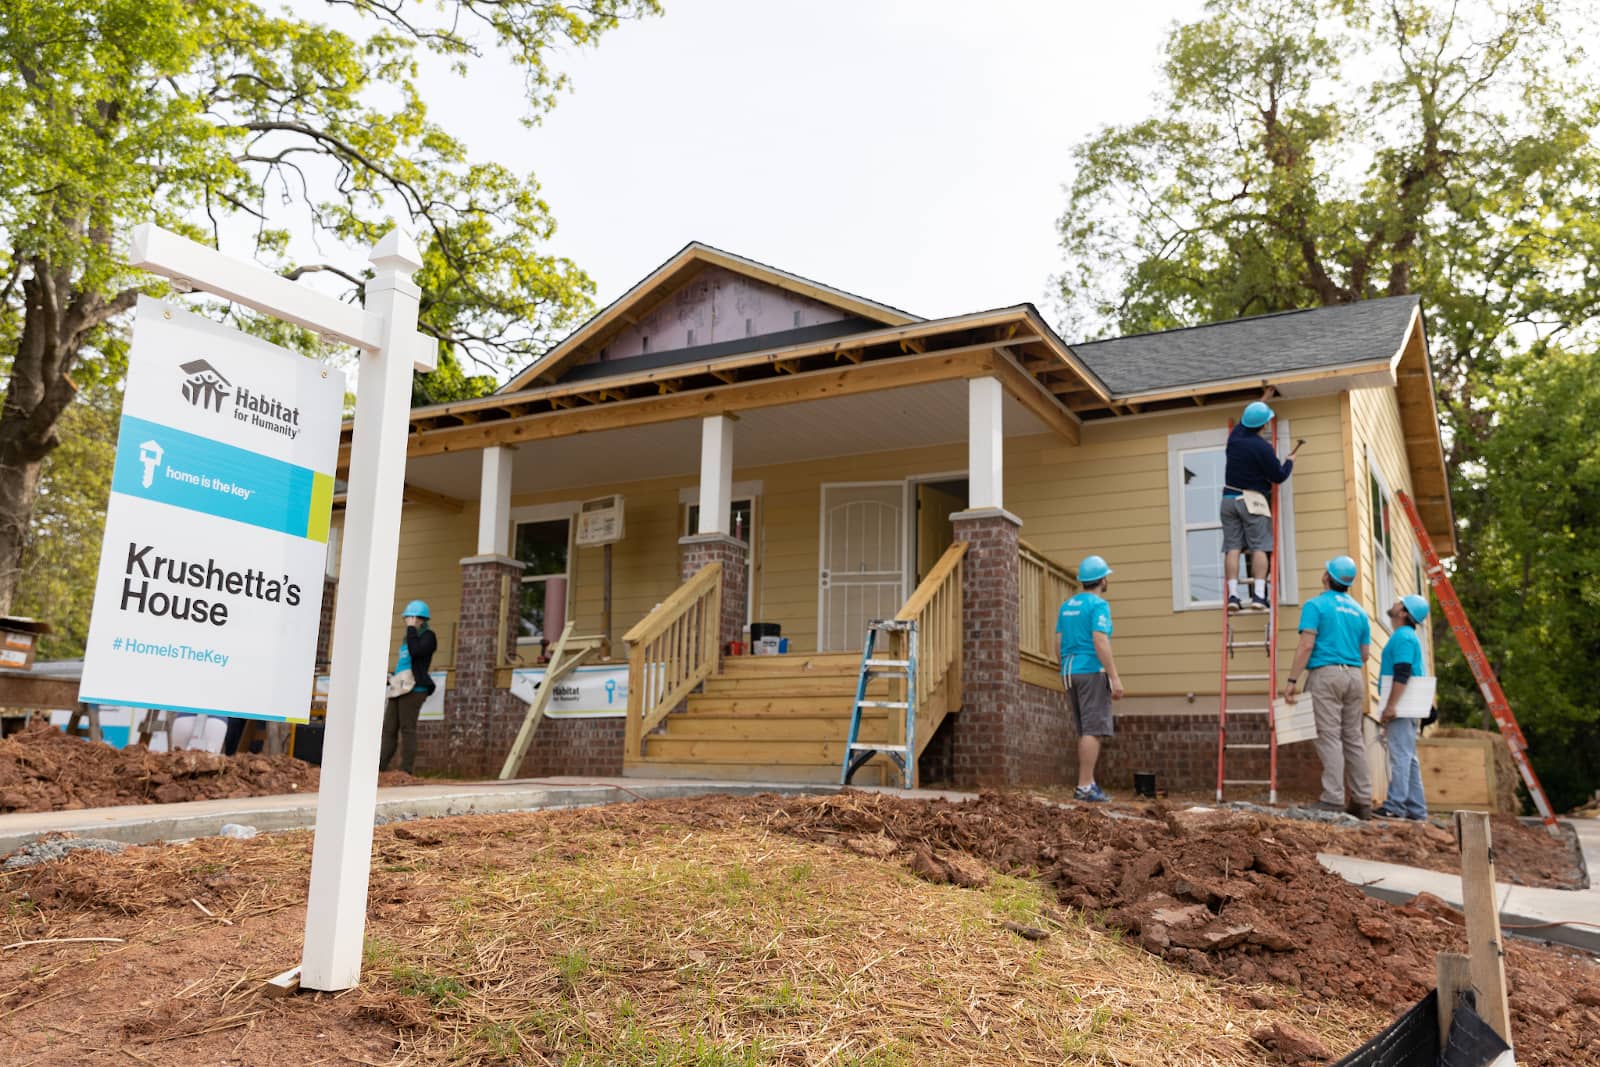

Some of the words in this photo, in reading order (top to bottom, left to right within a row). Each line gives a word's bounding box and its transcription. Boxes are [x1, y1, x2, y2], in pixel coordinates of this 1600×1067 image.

[233, 408, 249, 422] for
[251, 413, 298, 440] Humanity
[235, 386, 300, 426] Habitat
[166, 465, 200, 485] home
[201, 474, 211, 488] is
[212, 478, 230, 493] the
[231, 483, 250, 501] key
[126, 542, 301, 606] Krushetta's
[120, 577, 228, 626] House
